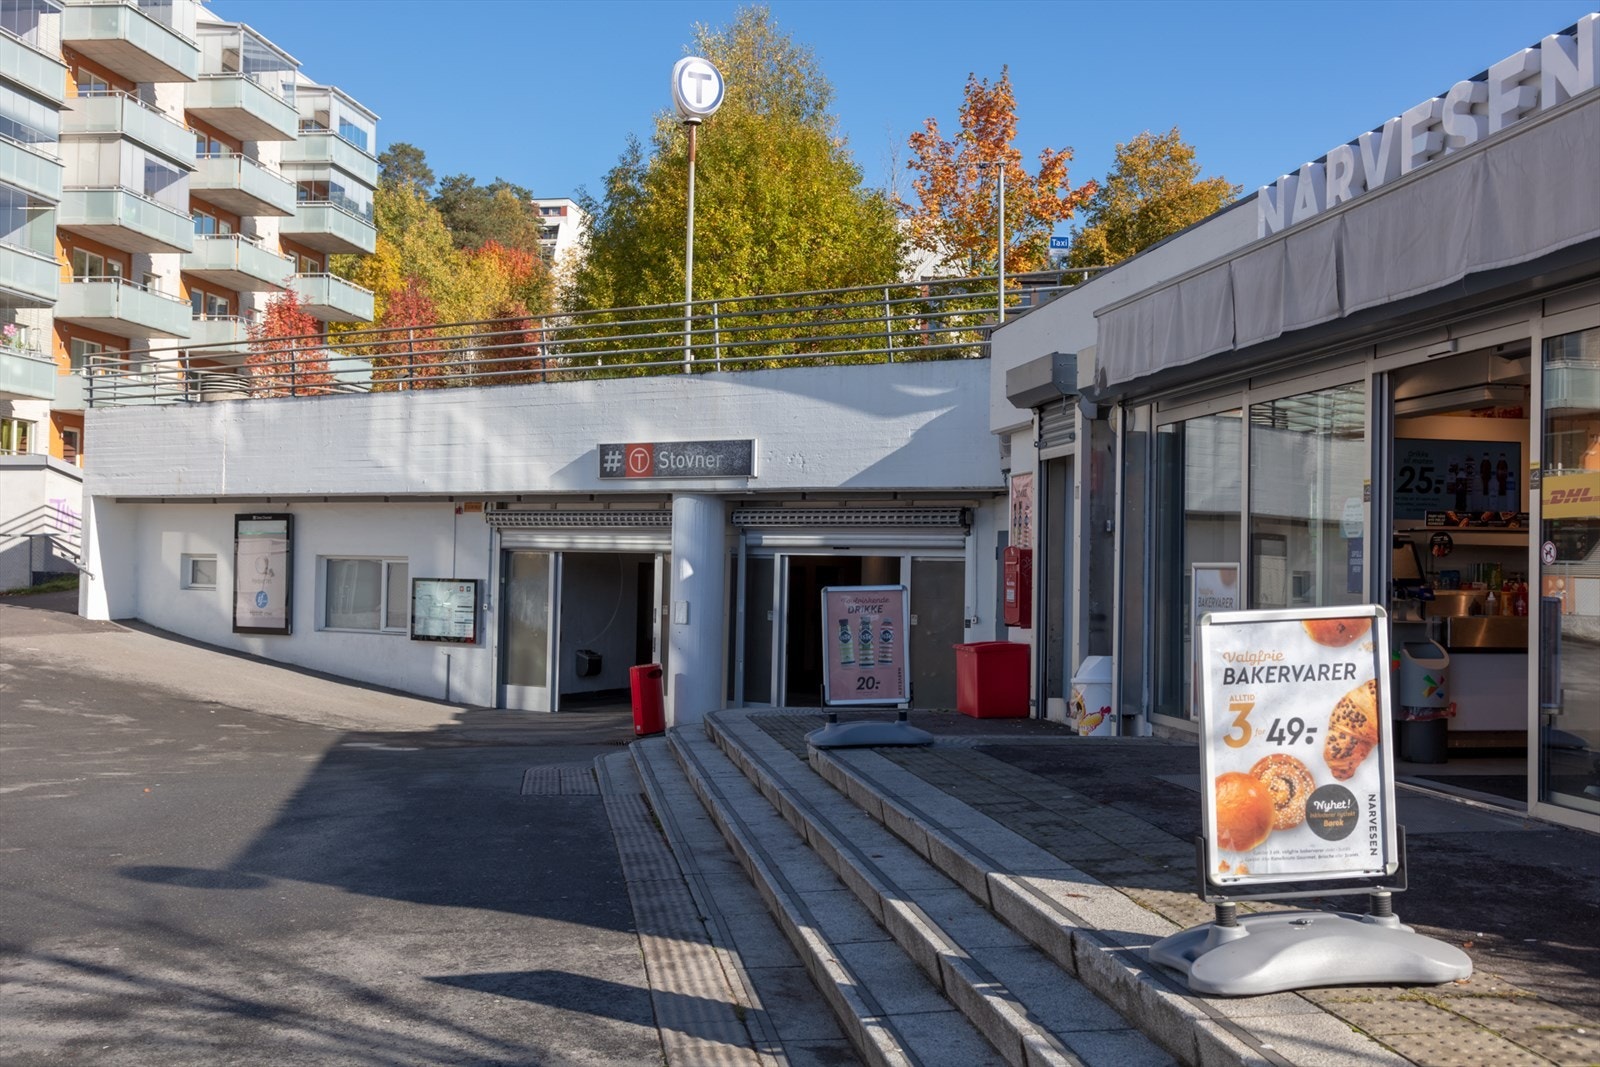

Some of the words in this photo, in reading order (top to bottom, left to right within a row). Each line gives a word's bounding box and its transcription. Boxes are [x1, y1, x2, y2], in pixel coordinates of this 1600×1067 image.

[688, 71, 712, 104] T
[1258, 13, 1599, 240] NARVESEN
[1052, 239, 1068, 247] Taxi
[659, 451, 723, 469] Stovner
[1550, 487, 1593, 505] DHL
[847, 605, 884, 614] DRIKKE
[1198, 596, 1234, 609] BAKERVARER
[1223, 650, 1285, 666] Valgfrie
[1223, 663, 1357, 685] BAKERVARER
[1229, 694, 1255, 702] ALLTID
[1223, 702, 1255, 749] 3
[1313, 798, 1351, 812] Nyhet!
[1368, 793, 1378, 857] NARVESEN
